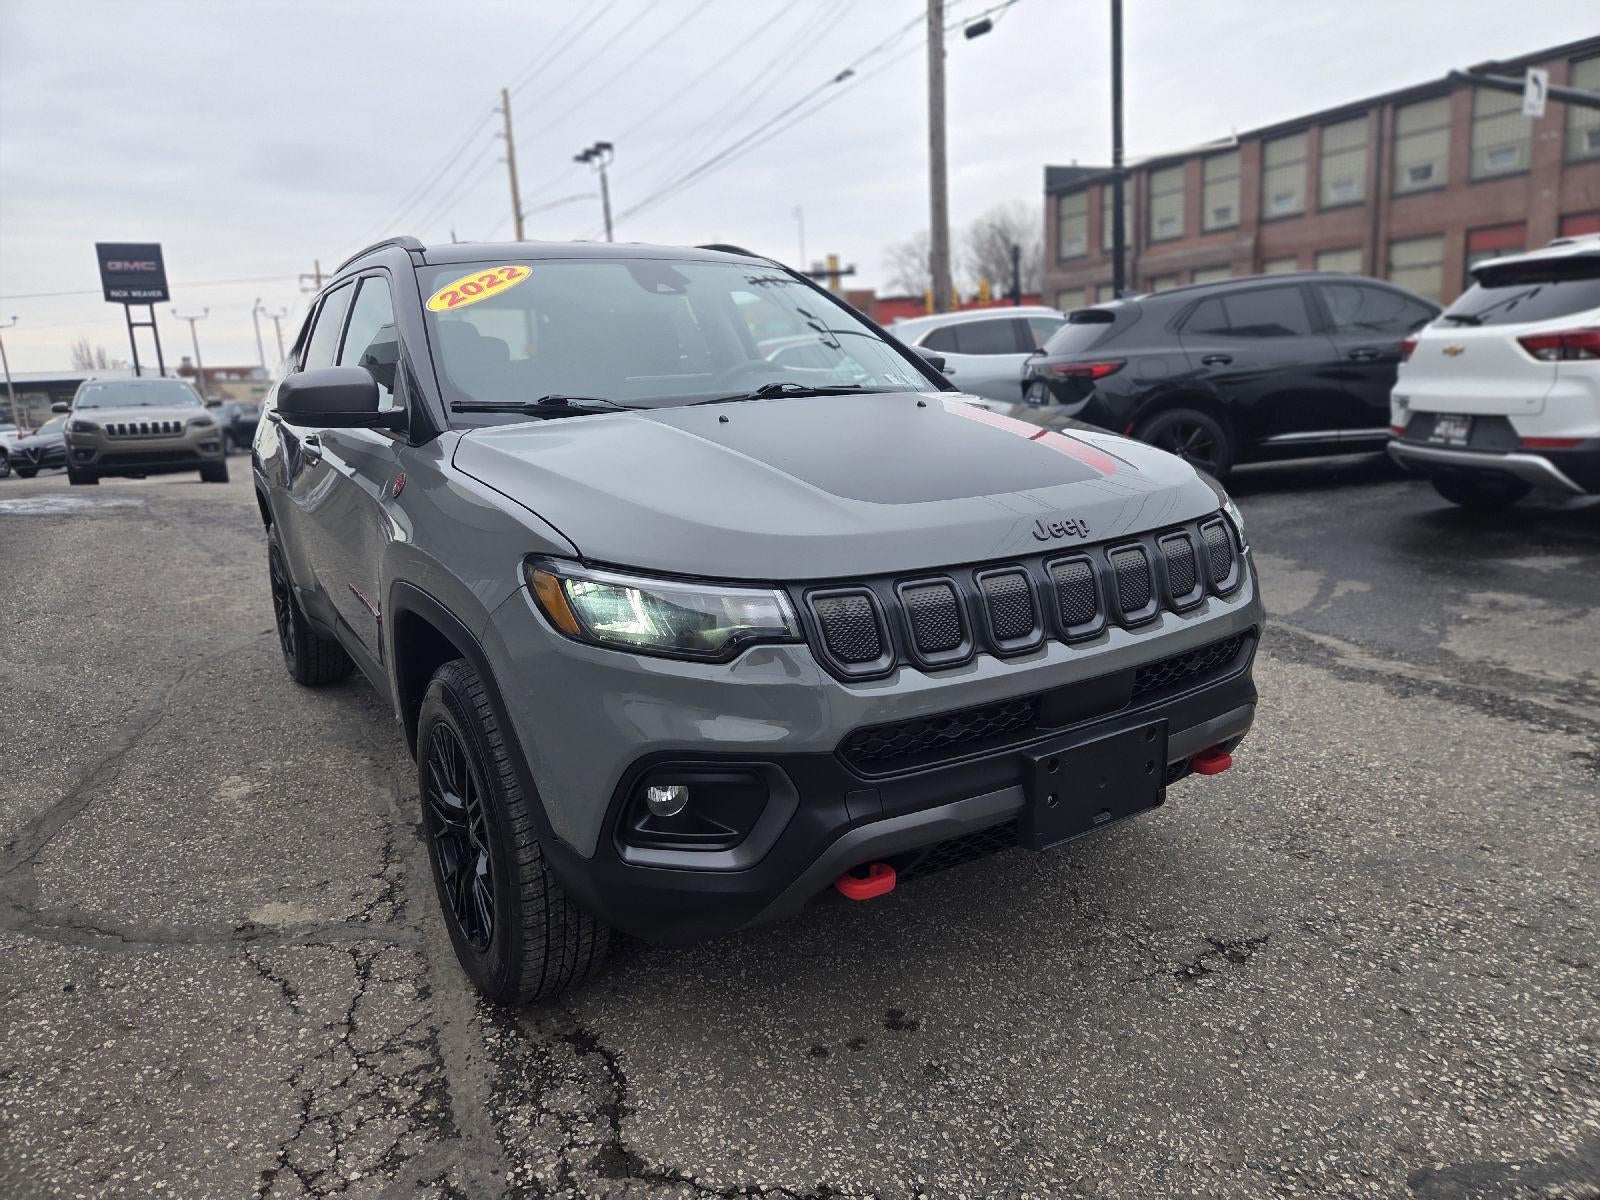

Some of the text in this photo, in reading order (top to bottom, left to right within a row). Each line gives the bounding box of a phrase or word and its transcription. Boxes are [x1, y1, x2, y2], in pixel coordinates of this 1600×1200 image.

[107, 261, 156, 271] GMC
[110, 290, 163, 298] RICK WEAVER
[440, 267, 525, 308] 2022
[1032, 517, 1090, 541] Jeep
